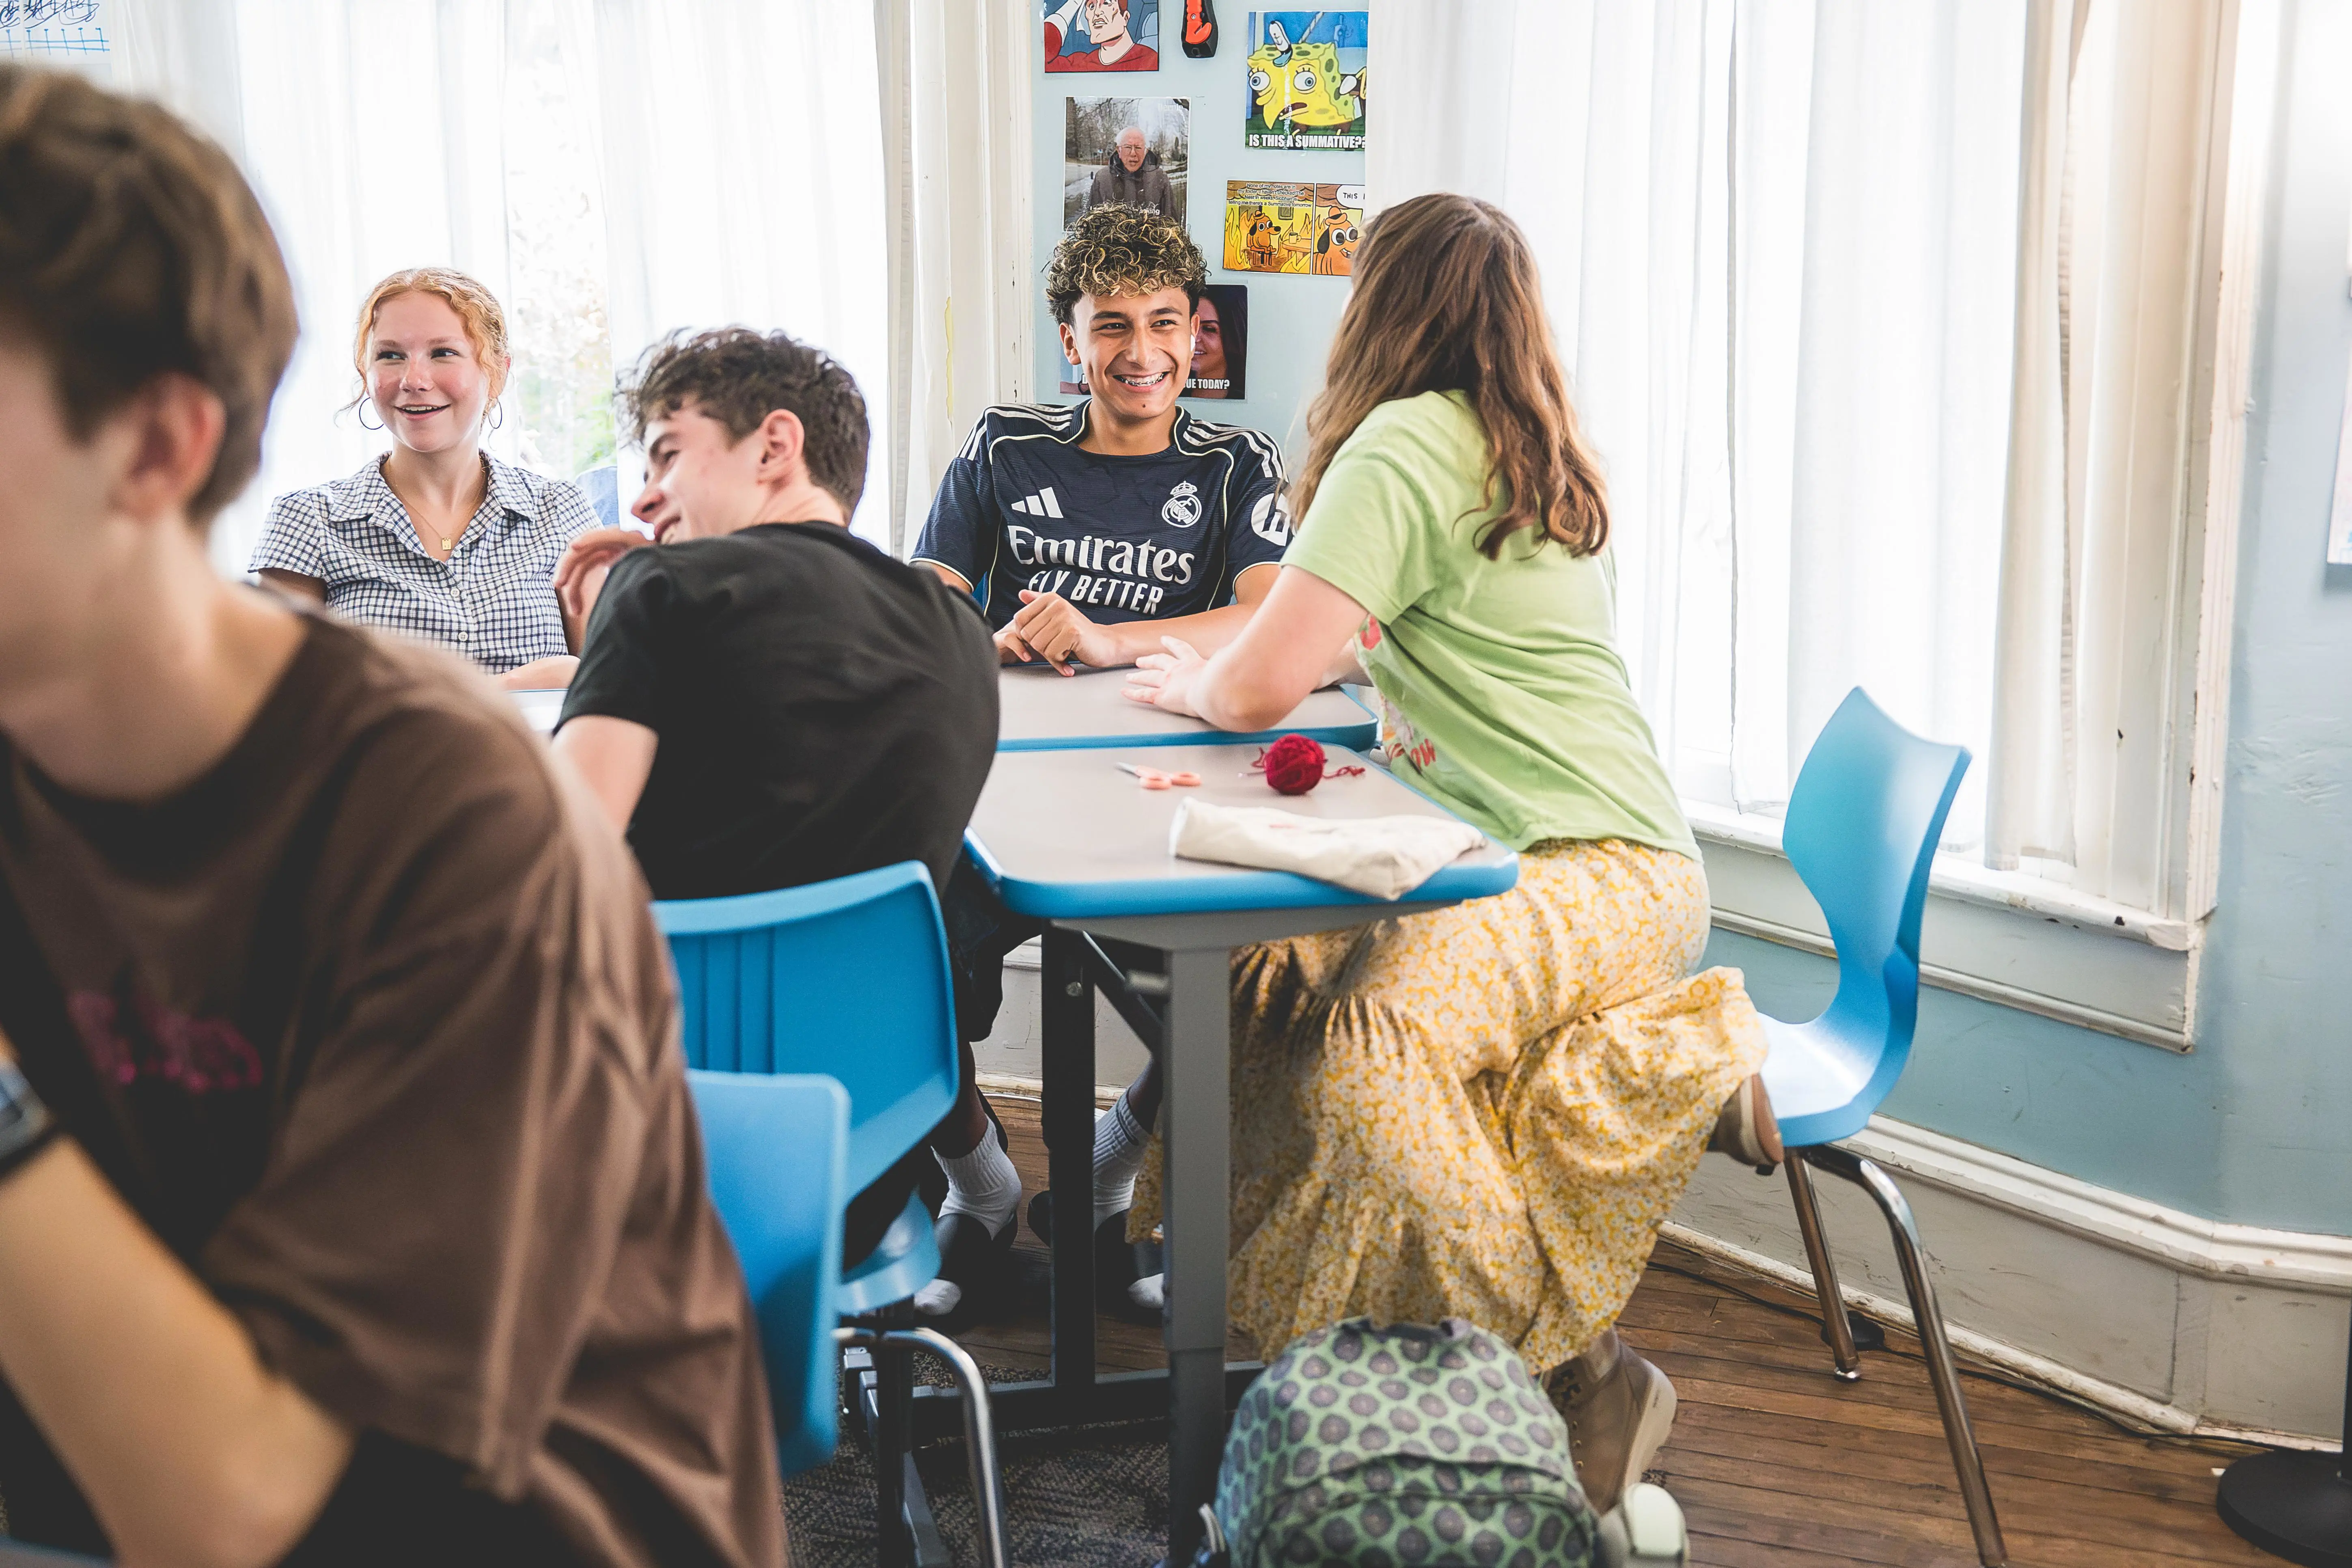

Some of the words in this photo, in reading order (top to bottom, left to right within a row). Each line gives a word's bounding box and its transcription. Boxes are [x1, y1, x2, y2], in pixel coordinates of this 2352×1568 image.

[1249, 134, 1259, 147] IS
[1261, 134, 1285, 147] THIS
[1287, 135, 1293, 147] A
[1185, 379, 1196, 388] UE
[1198, 379, 1230, 389] TODAY?
[1007, 525, 1195, 584] Emirates
[1070, 575, 1164, 615] BETTER
